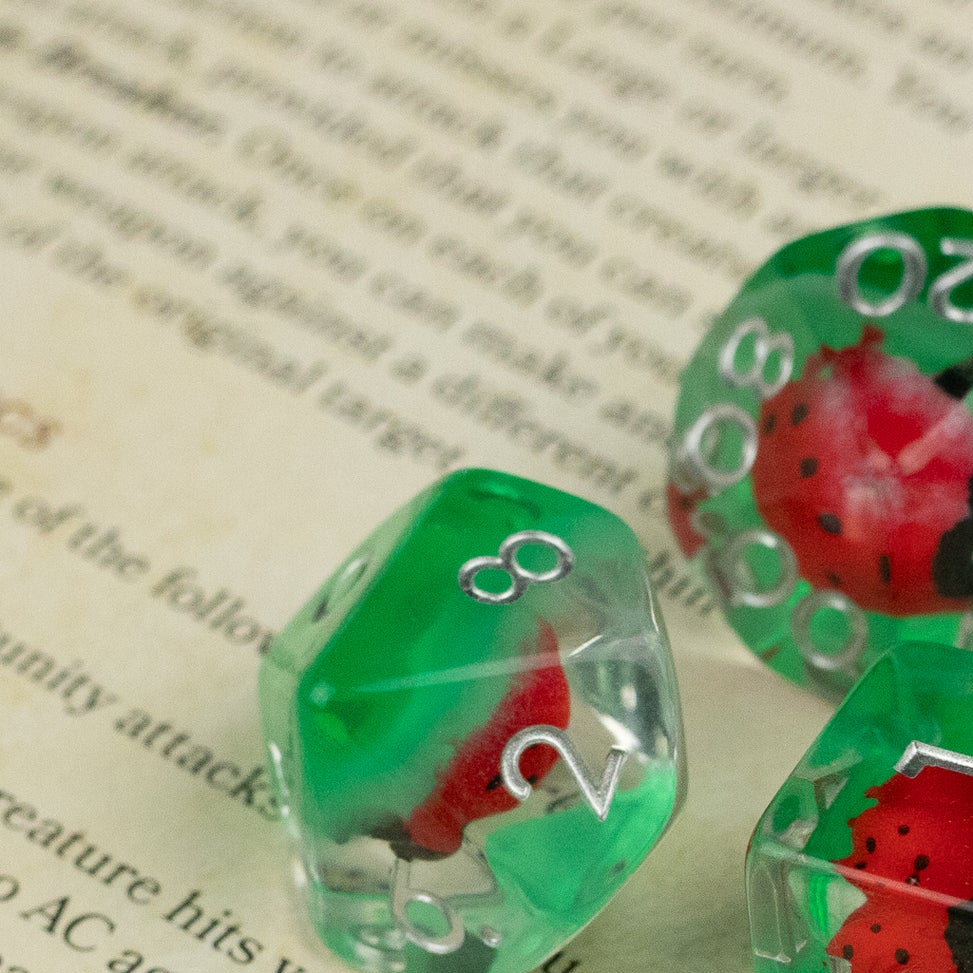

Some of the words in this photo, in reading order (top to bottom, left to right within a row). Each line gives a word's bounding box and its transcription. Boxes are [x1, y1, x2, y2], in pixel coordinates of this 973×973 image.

[11, 496, 86, 537] of
[66, 521, 152, 582] the
[458, 530, 575, 604] 8
[502, 724, 627, 822] 2
[20, 895, 117, 952] AC
[162, 889, 265, 966] hits
